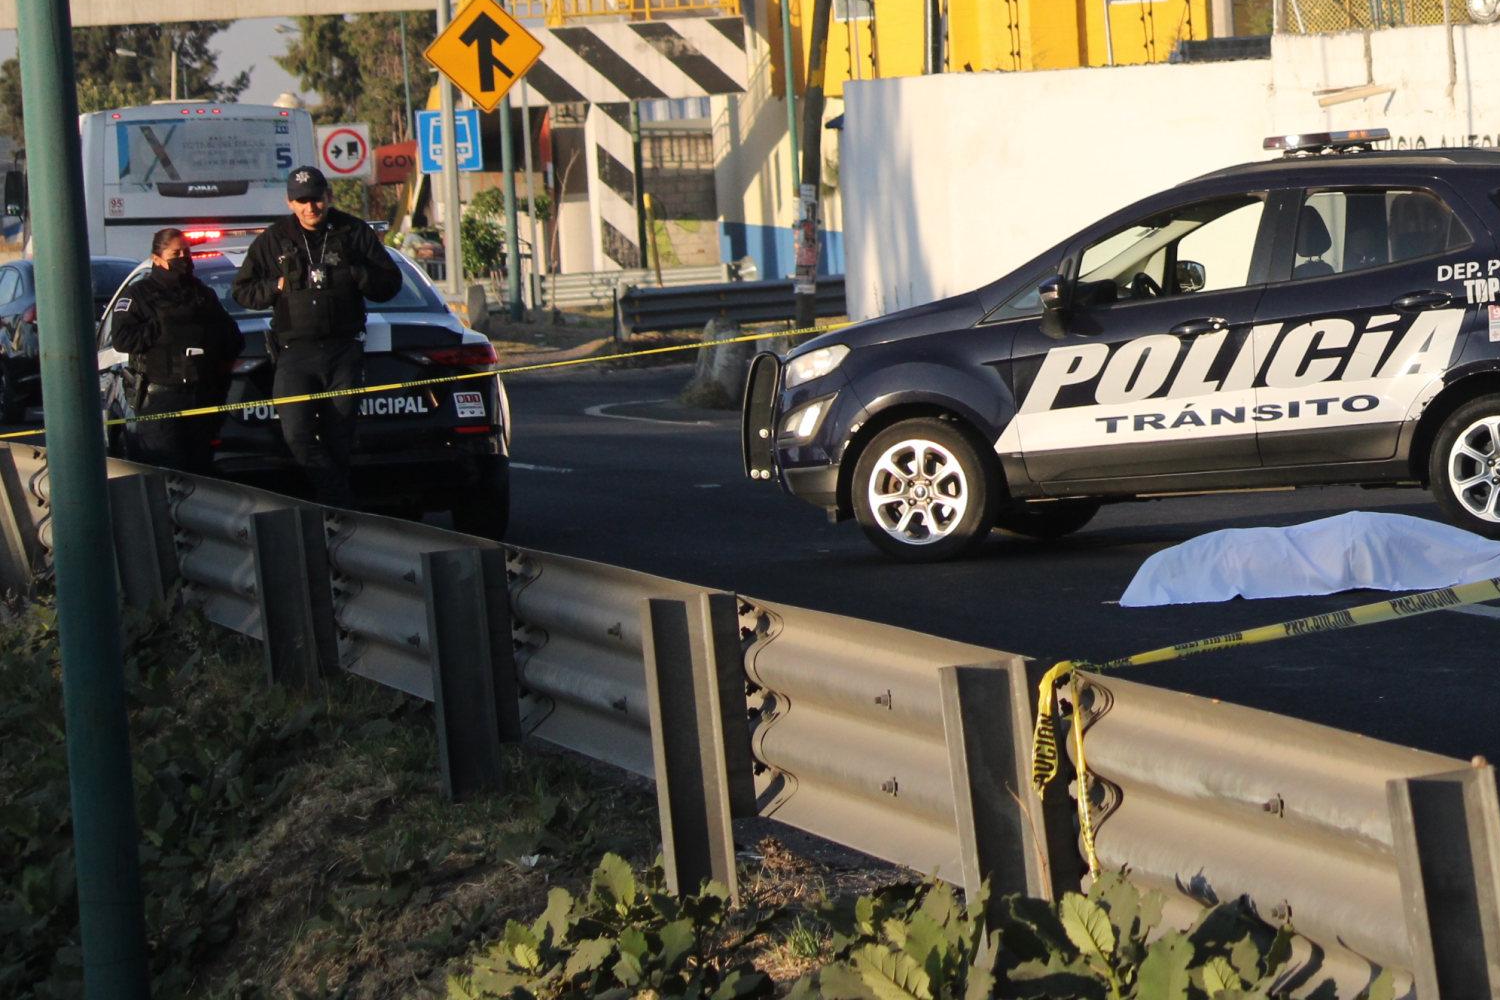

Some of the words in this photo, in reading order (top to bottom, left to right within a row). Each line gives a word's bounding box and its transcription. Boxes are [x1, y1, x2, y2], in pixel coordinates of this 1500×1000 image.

[276, 148, 292, 168] 5
[1437, 261, 1482, 282] DEP.
[1095, 395, 1380, 434] TRÁNSITO
